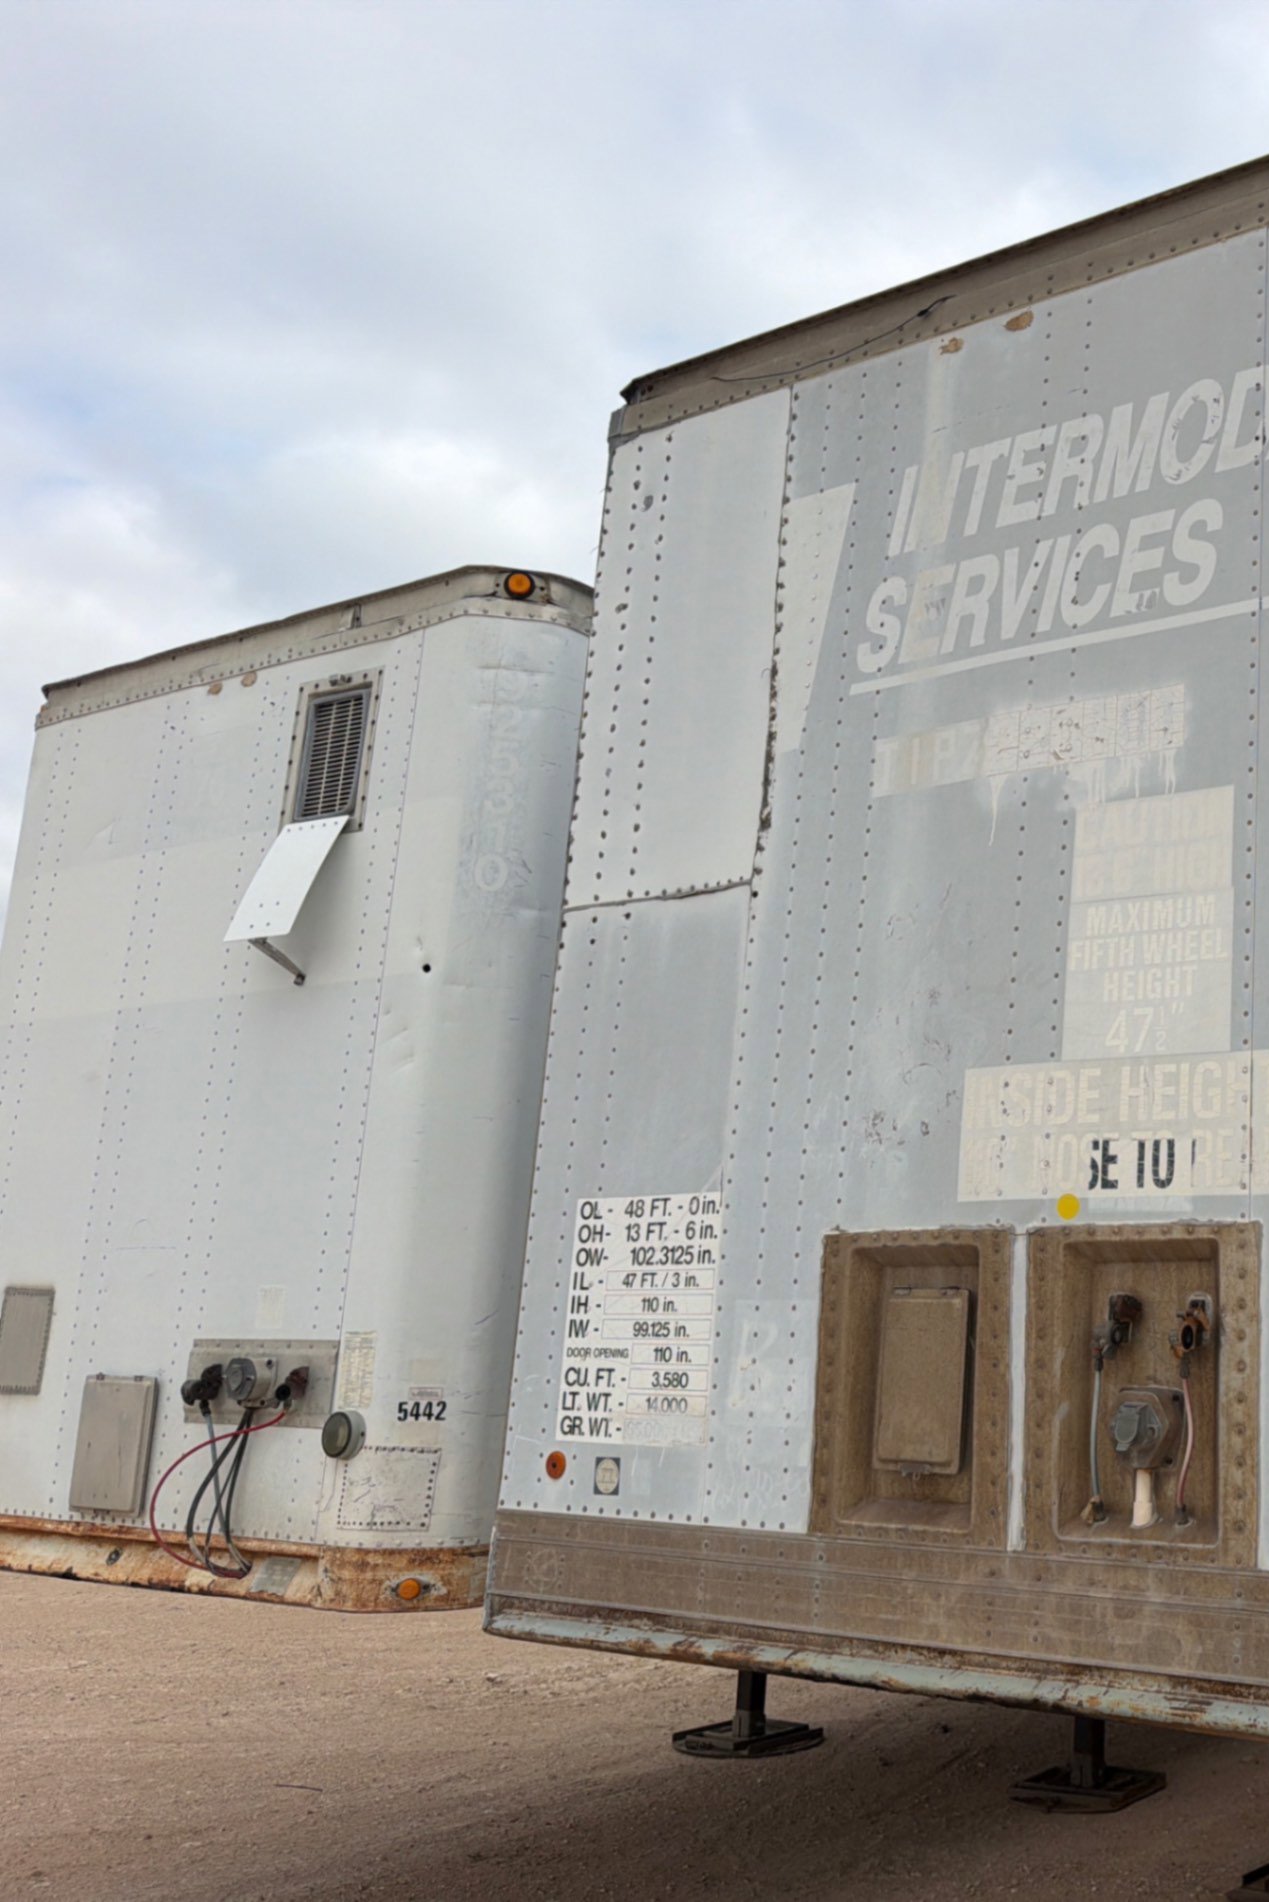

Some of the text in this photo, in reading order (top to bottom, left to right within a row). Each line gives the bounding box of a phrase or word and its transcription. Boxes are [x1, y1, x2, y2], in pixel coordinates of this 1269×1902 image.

[857, 499, 1223, 673] SERVICES
[1086, 895, 1216, 936] MAXIMUM
[1069, 927, 1228, 970] FIFTH WHEEL
[1103, 965, 1197, 1001] HEIGHT
[965, 1067, 1101, 1129] INSIDE
[1132, 1130, 1176, 1190] TO
[580, 1200, 603, 1220] OL
[624, 1198, 645, 1218] 48
[650, 1197, 672, 1217] FT.
[688, 1196, 700, 1215] 0
[701, 1195, 720, 1214] in.
[625, 1222, 641, 1242] 13
[646, 1221, 668, 1241] FT.
[685, 1220, 696, 1240] 6
[699, 1220, 718, 1240] in.
[630, 1245, 695, 1266] 102.3125
[697, 1245, 716, 1264] in.
[622, 1272, 637, 1288] 47
[640, 1272, 659, 1288] FT.
[671, 1272, 681, 1288] 3
[684, 1271, 700, 1287] in.
[570, 1295, 589, 1314] IH
[641, 1297, 660, 1312] 110
[662, 1297, 678, 1312] in.
[568, 1319, 590, 1338] IW
[632, 1321, 670, 1338] 99.125
[674, 1321, 690, 1337] in.
[566, 1346, 692, 1363] DOOR OPENING 110 in.
[564, 1367, 590, 1387] CU.
[595, 1368, 616, 1388] FT.
[397, 1400, 448, 1421] 5442
[561, 1391, 581, 1411] LT.
[587, 1392, 612, 1412] WT.
[560, 1416, 585, 1436] GR.
